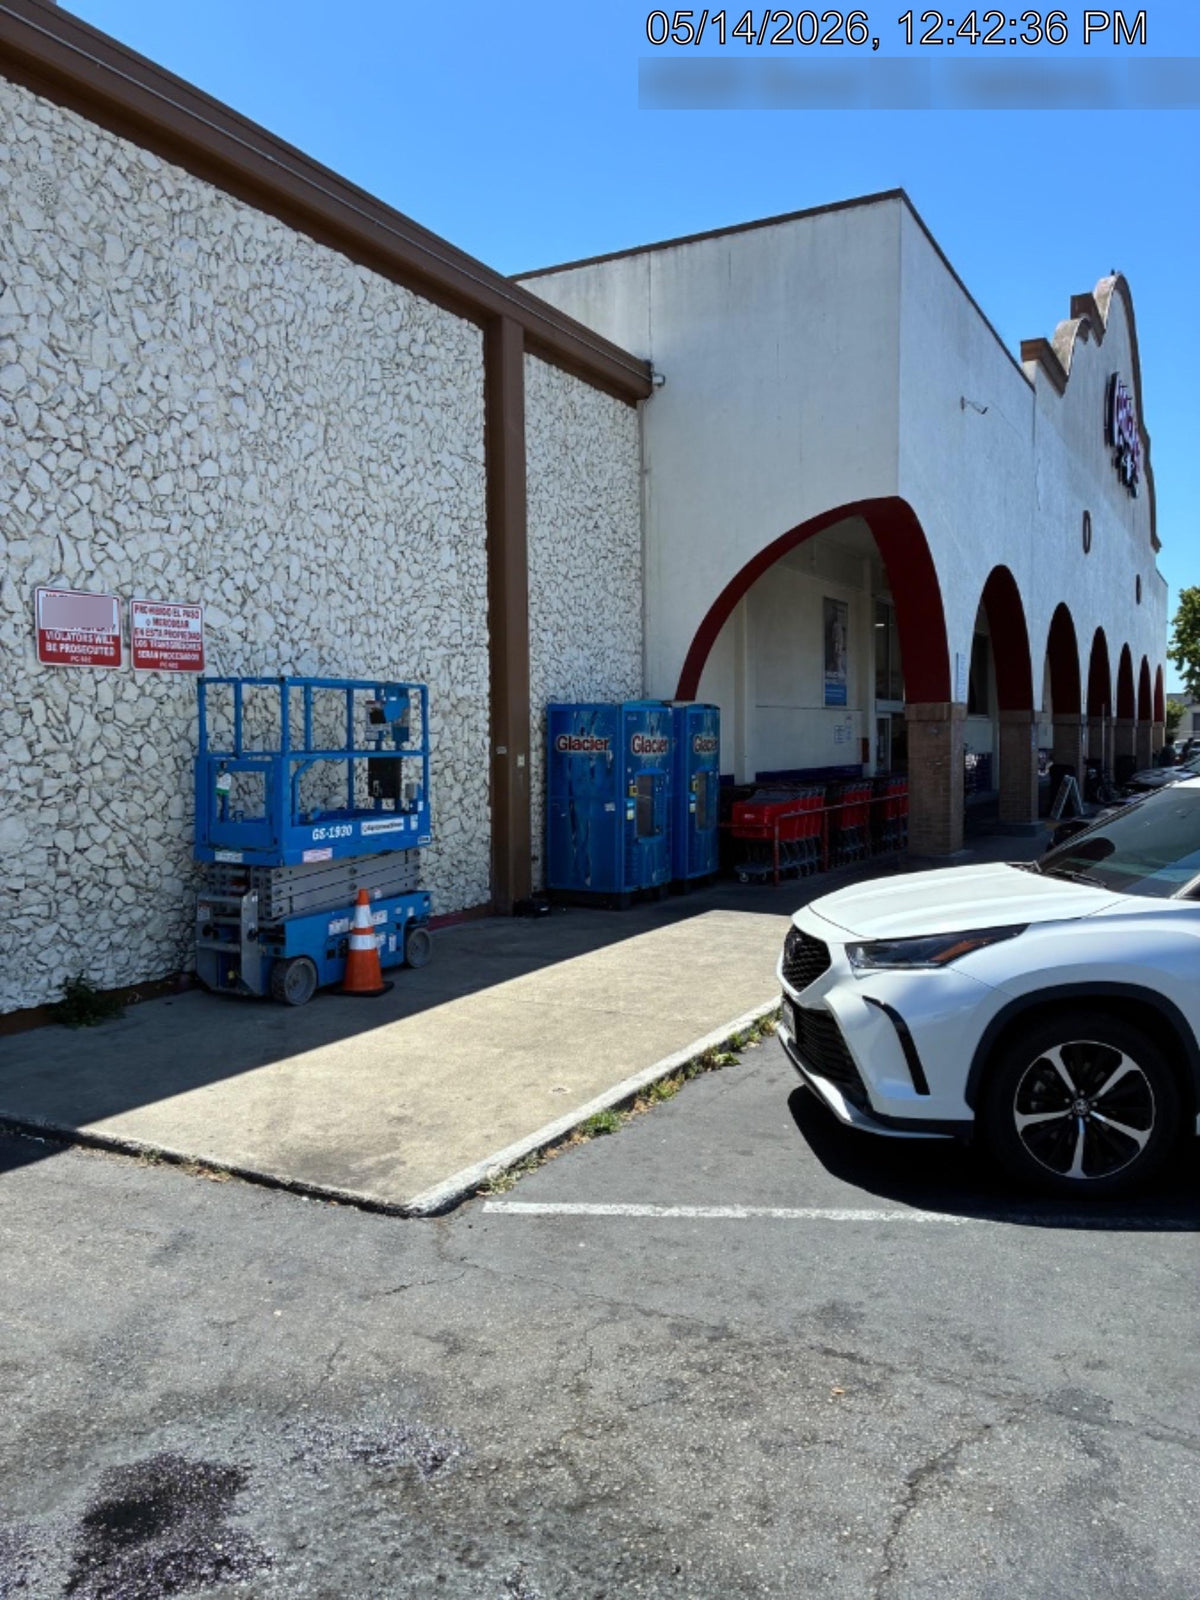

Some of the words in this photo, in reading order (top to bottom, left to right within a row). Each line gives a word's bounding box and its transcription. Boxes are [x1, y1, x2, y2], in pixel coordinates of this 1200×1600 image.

[45, 630, 93, 643] VIOLATORS
[94, 634, 115, 645] WILL
[45, 642, 58, 652] BE
[59, 643, 115, 657] PROSECUTED
[556, 735, 610, 751] Glacier
[631, 735, 669, 754] Glacier
[693, 735, 718, 752] Glacier
[312, 824, 353, 841] GS-1930
